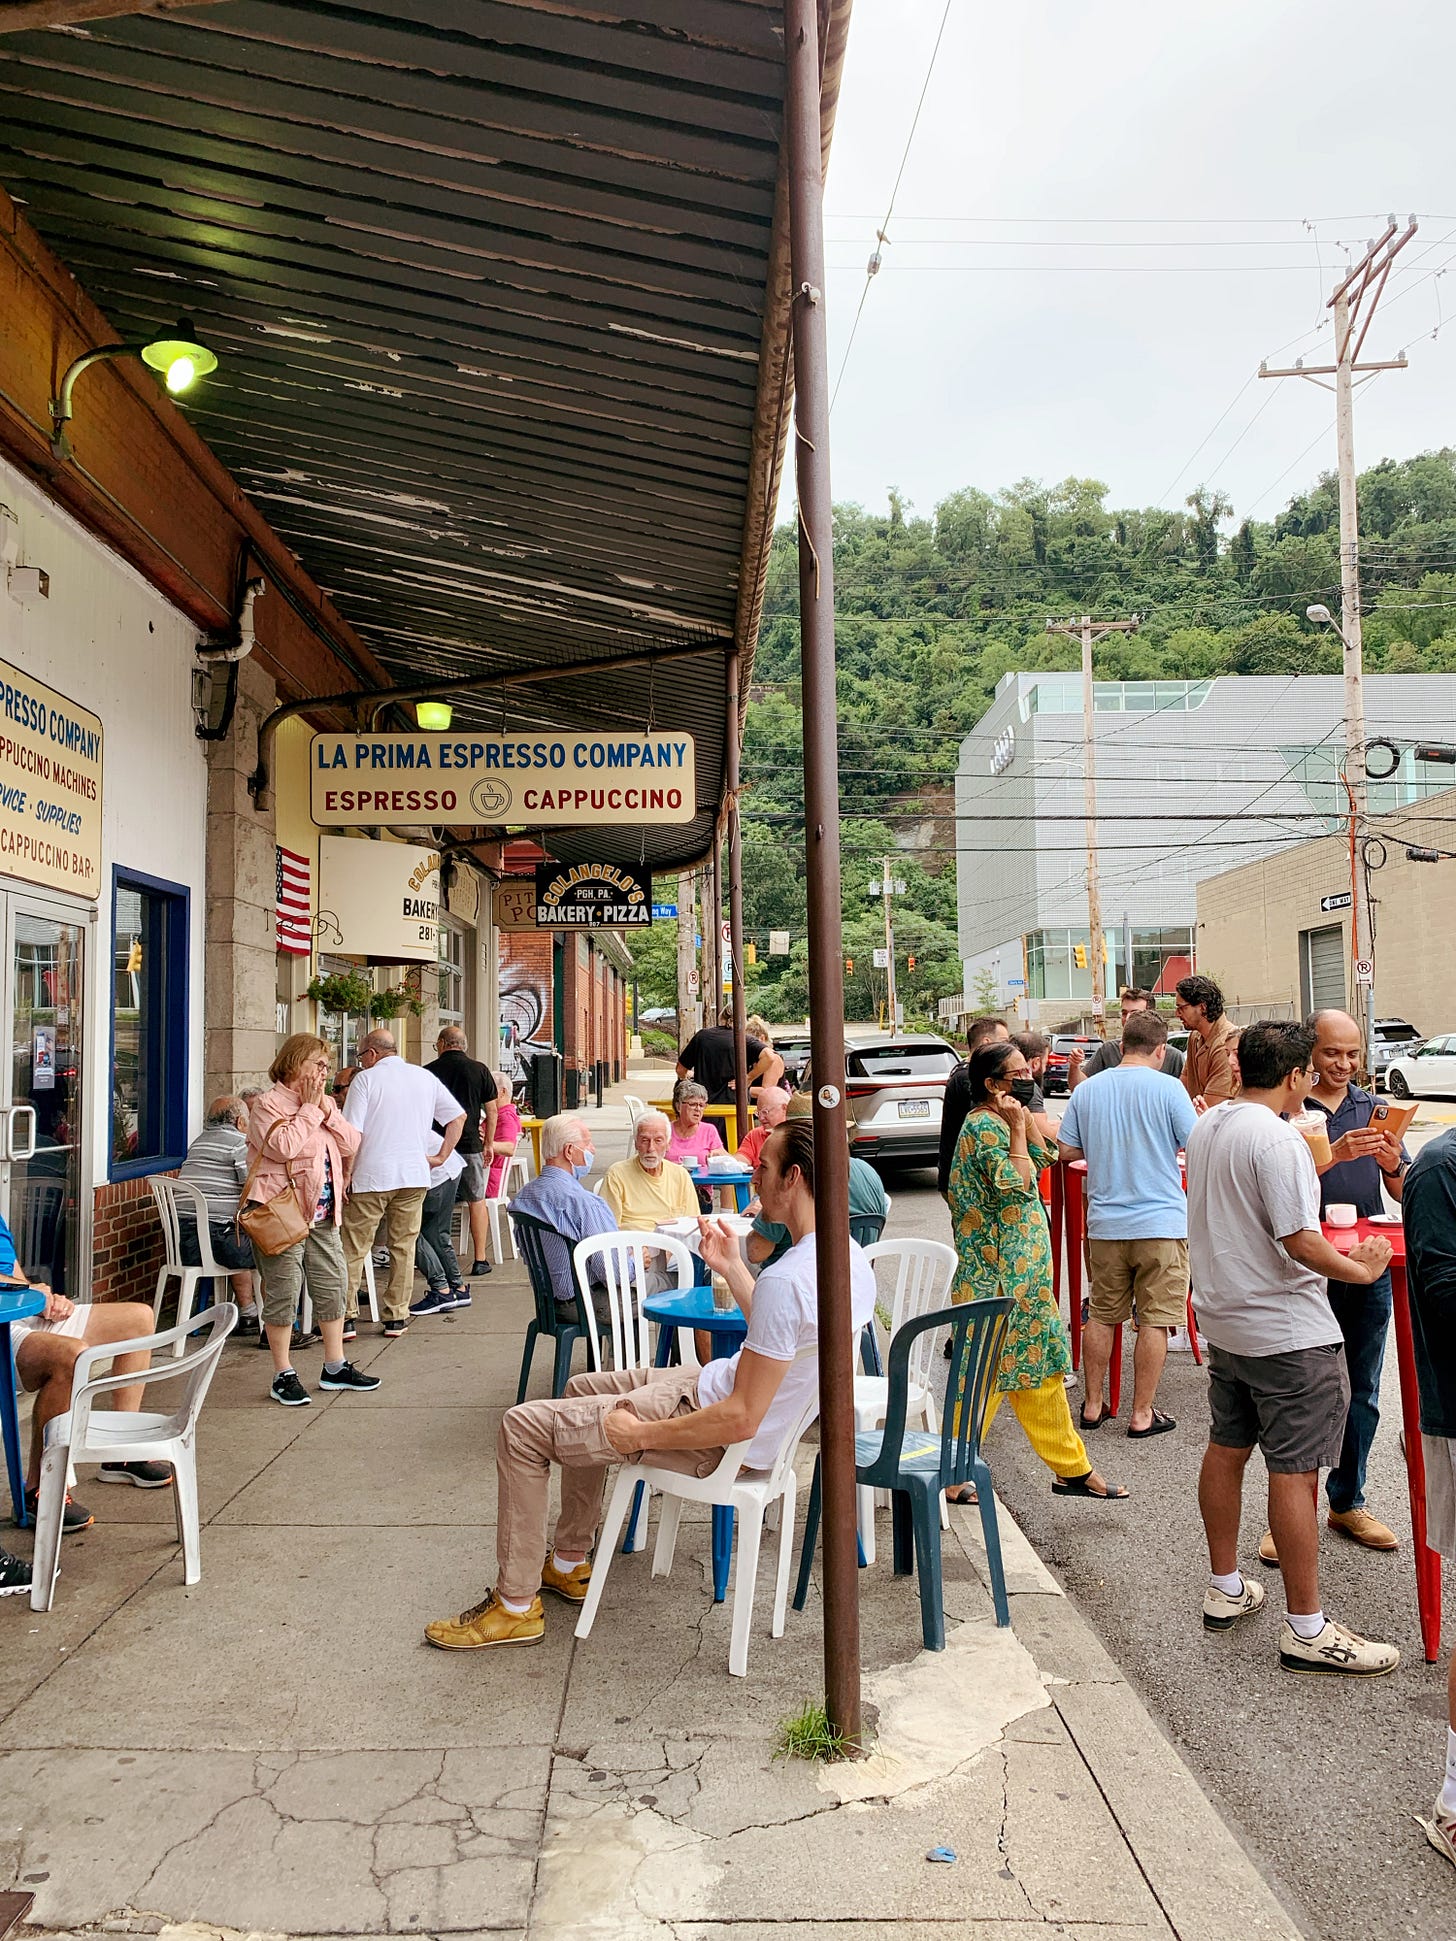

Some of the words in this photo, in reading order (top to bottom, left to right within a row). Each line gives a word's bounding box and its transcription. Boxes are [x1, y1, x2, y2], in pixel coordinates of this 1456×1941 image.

[50, 710, 101, 764] COMPANY
[317, 743, 348, 769] LA
[355, 743, 432, 769] PRIMA
[439, 742, 566, 769] ESPRESSO
[573, 742, 687, 769] COMPANY
[53, 761, 97, 802] MACHINES
[325, 790, 458, 811] ESPRESSO
[523, 788, 683, 810] CAPPUCCINO
[35, 799, 82, 836] SUPPLIES
[1, 828, 68, 872] CAPPUCCINO
[543, 863, 645, 905] COLANGELO'S
[576, 889, 598, 900] PGH,
[537, 905, 595, 922] BAKERY
[603, 905, 650, 922] PIZZA
[660, 907, 672, 918] Way
